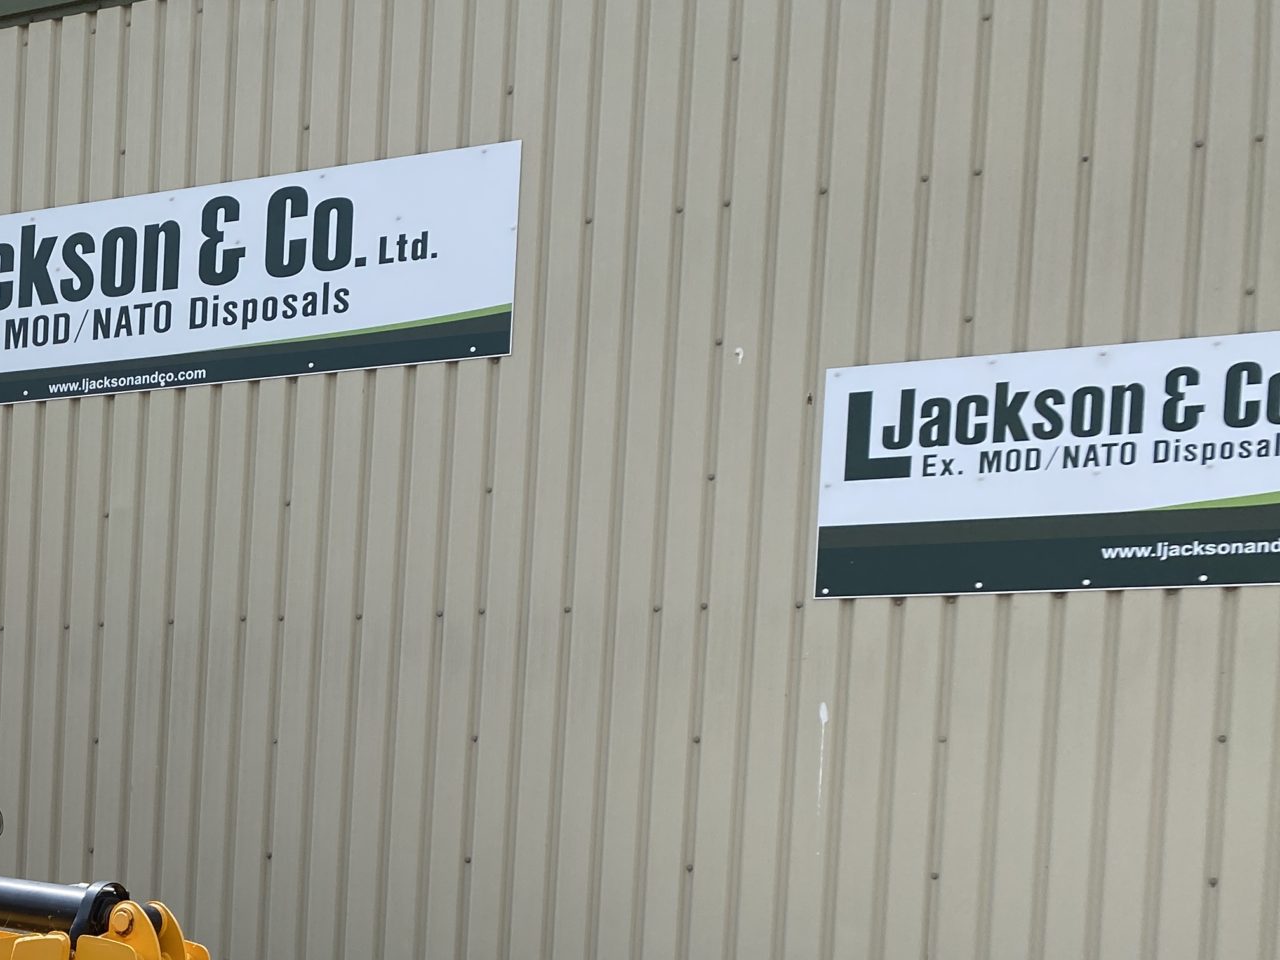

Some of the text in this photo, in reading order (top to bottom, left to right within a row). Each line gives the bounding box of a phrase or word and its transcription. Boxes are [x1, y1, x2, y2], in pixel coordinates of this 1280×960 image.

[198, 195, 246, 286] &
[265, 186, 367, 278] Co.
[378, 231, 438, 265] Ltd.
[4, 300, 173, 351] MOD/NATO
[189, 282, 350, 331] Disposals
[48, 369, 207, 393] www.ljacksonandco.com
[1162, 366, 1205, 432] &
[922, 453, 963, 477] Ex.
[979, 441, 1137, 474] MOD/NATO
